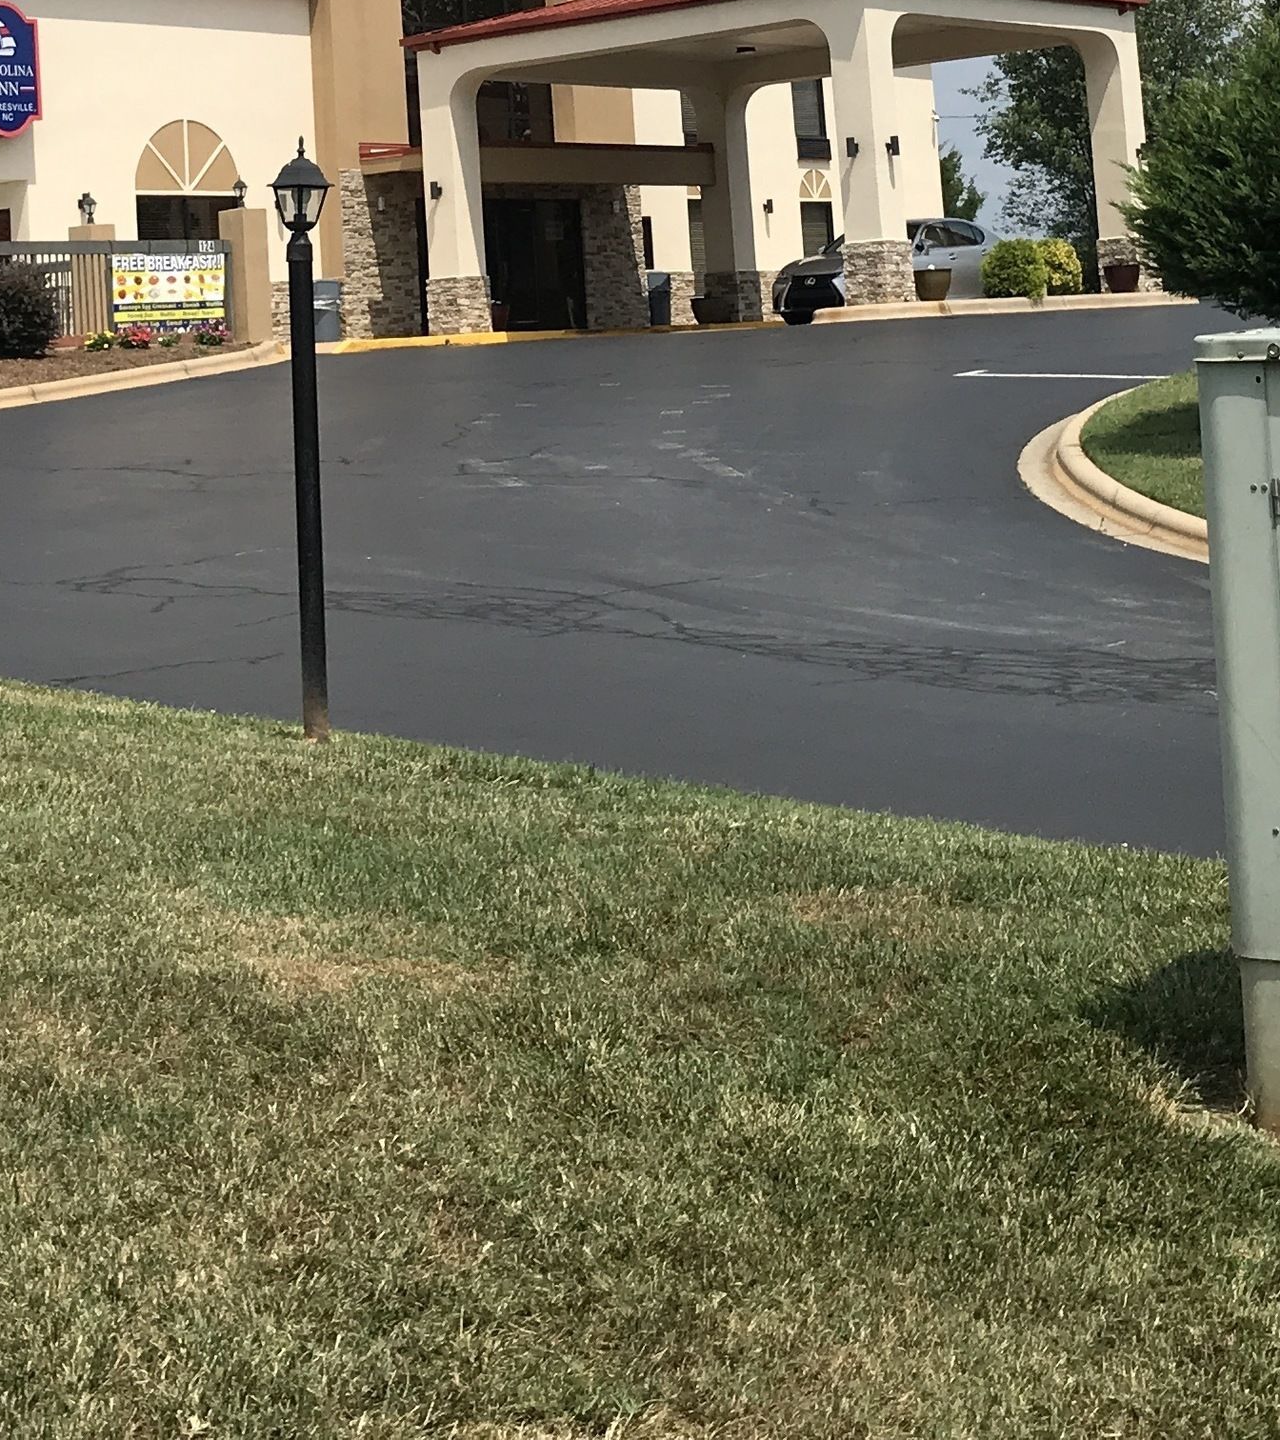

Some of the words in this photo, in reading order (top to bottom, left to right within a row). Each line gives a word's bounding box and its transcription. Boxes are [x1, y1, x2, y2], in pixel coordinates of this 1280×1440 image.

[2, 113, 14, 121] NC
[200, 241, 214, 252] 124
[113, 254, 145, 272] FREE
